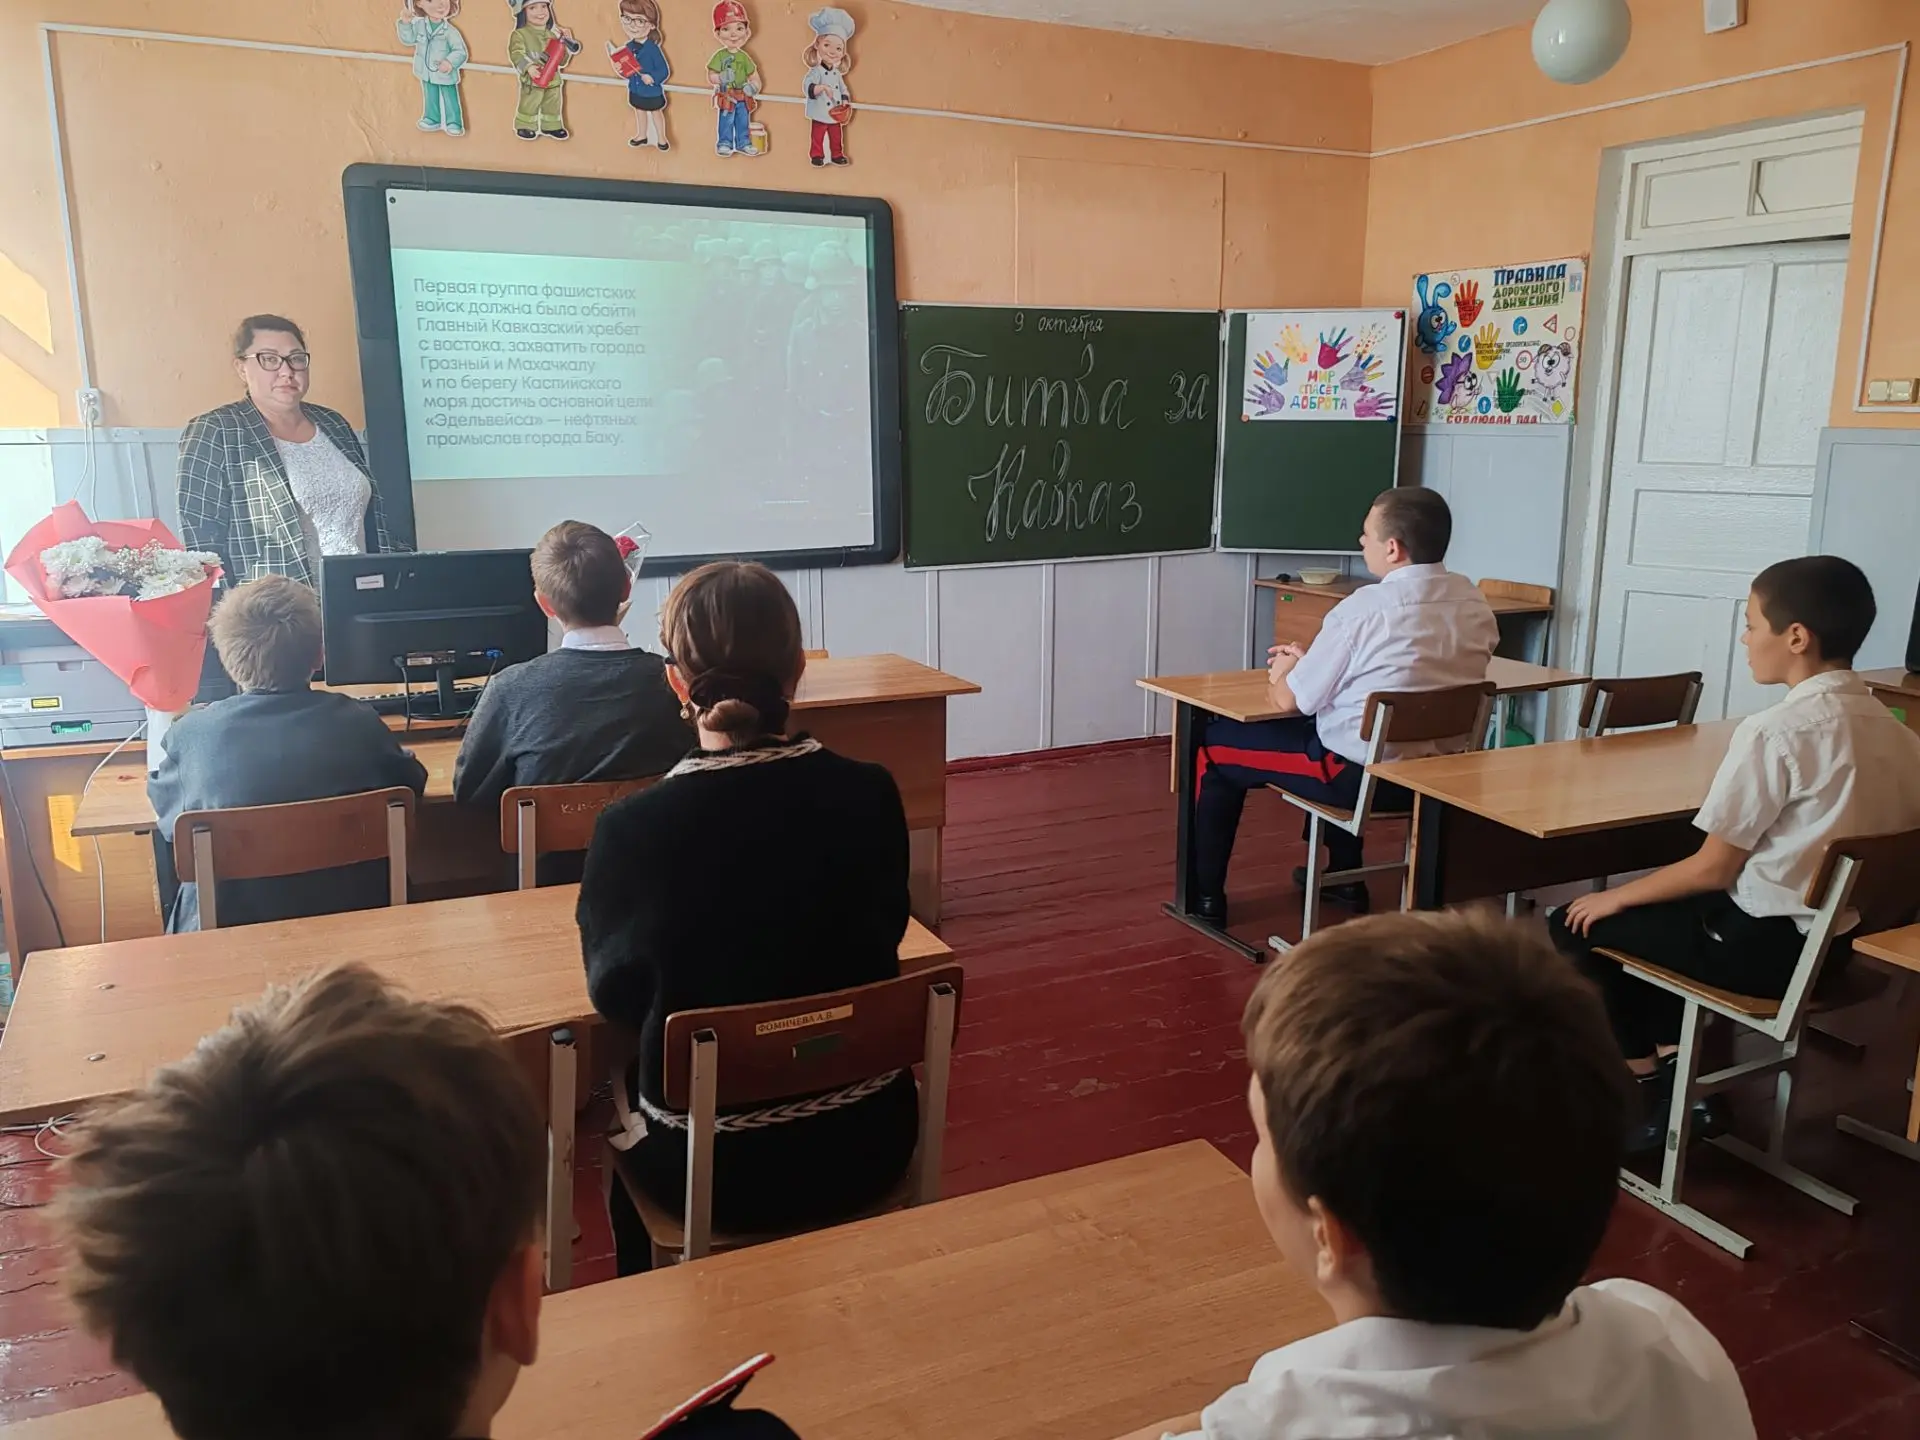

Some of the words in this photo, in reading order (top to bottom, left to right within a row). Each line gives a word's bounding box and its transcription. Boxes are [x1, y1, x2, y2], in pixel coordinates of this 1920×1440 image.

[1493, 264, 1567, 286] ПРАВИЛА
[413, 278, 476, 296] Первая
[480, 282, 538, 298] группа
[541, 283, 636, 300] фашистских
[1492, 281, 1560, 298] ДОРОЖНОГО
[416, 299, 465, 313] войск
[468, 301, 532, 316] должна
[536, 300, 578, 316] была
[581, 303, 636, 318] обойти
[417, 317, 488, 333] Главный
[491, 319, 584, 335] Кавказский
[587, 321, 641, 337] хребет
[1014, 311, 1025, 332] 9
[1038, 314, 1104, 340] октября
[418, 340, 429, 351] с
[433, 339, 504, 353] востока,
[508, 341, 587, 353] захватить
[591, 341, 646, 355] города
[420, 356, 490, 372] Грозный
[494, 360, 503, 370] и
[507, 358, 596, 374] Махачкалу
[422, 378, 432, 388] и
[436, 378, 457, 389] по
[461, 375, 518, 392] берегу
[522, 376, 622, 390] Каспийского
[1307, 370, 1336, 383] МИР
[919, 344, 1137, 430] Битва
[423, 396, 467, 411] моря
[471, 397, 536, 410] достичь
[539, 394, 614, 408] основной
[1290, 395, 1348, 410] ДОБРОТА
[425, 412, 543, 429] «Эдельвейса»
[564, 413, 637, 427] нефтяных
[1446, 413, 1512, 424] СОБЛЮДАЙ
[426, 431, 523, 448] промыслов
[525, 432, 582, 446] города
[586, 431, 624, 445] Баку.
[967, 439, 1143, 542] Кавказ
[758, 1015, 816, 1032] ФОМИЧЕВА
